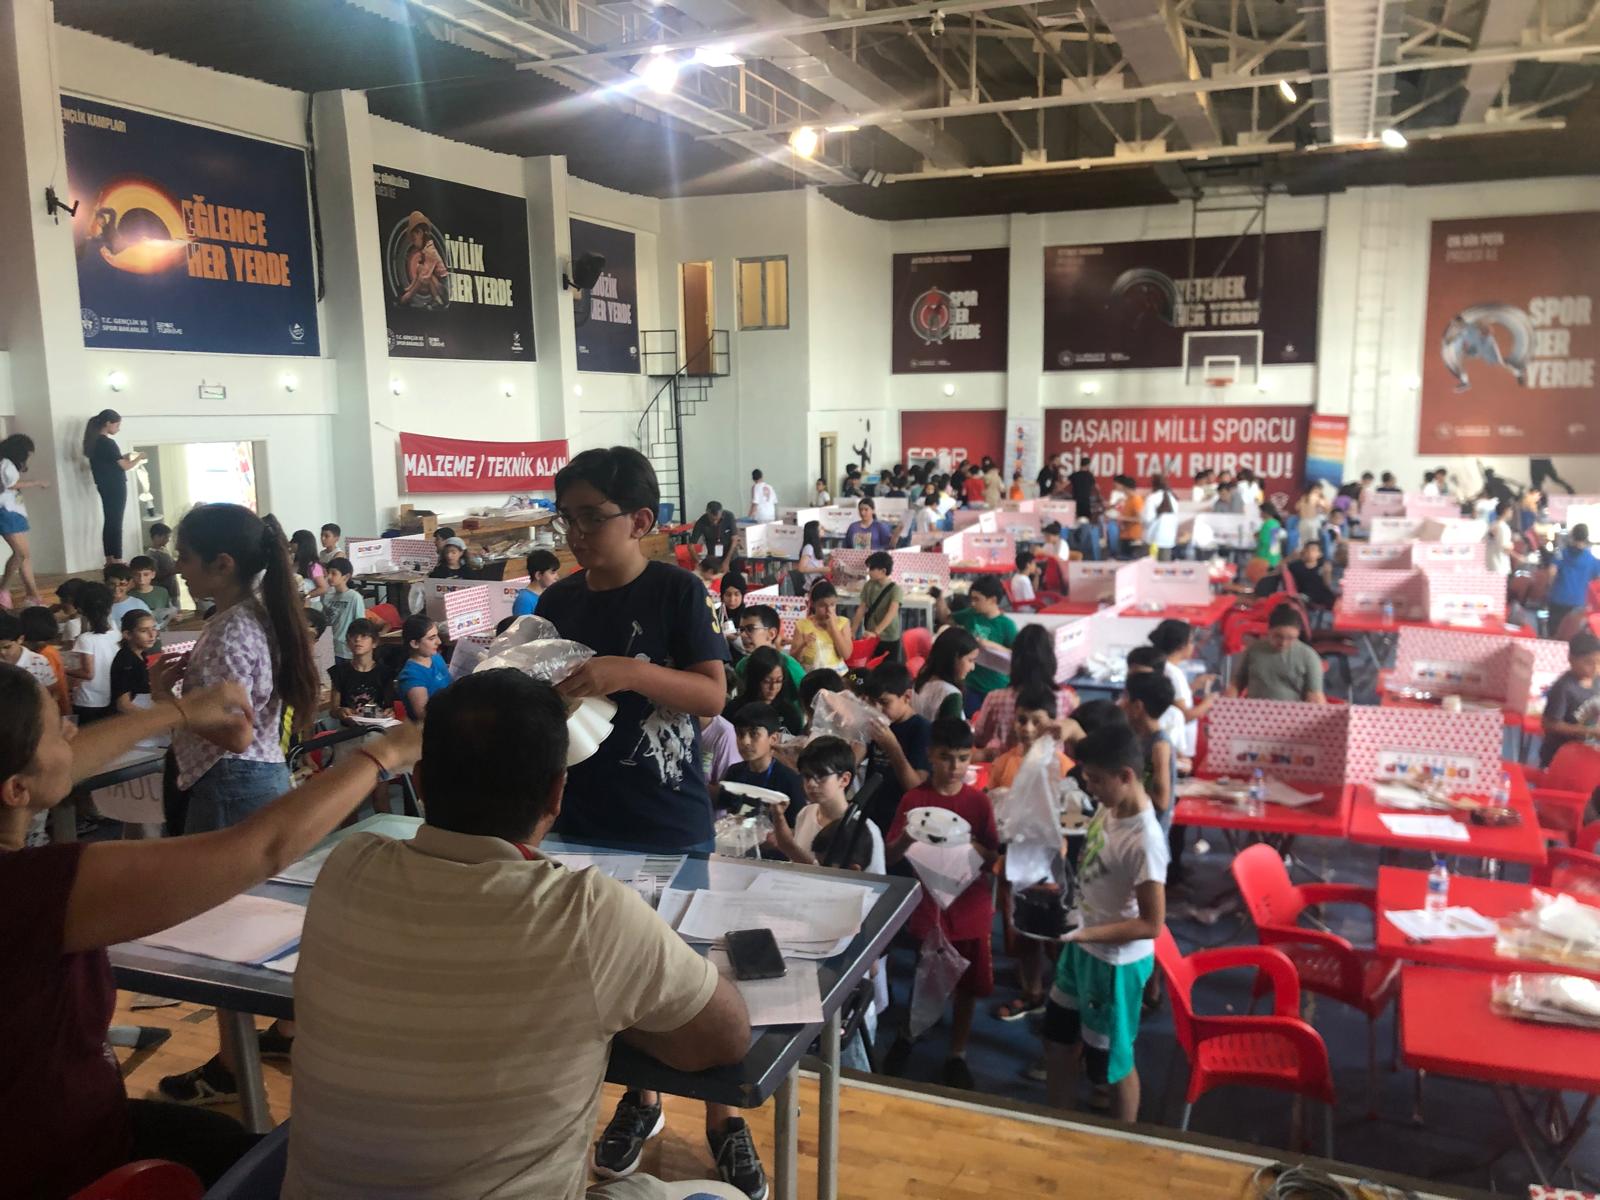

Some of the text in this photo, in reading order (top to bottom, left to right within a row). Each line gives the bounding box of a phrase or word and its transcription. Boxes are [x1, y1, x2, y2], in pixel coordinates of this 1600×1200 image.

[62, 108, 86, 124] ENÇLİK
[181, 194, 268, 247] EĞLENCE
[186, 242, 292, 287] HER YERDE
[445, 233, 485, 272] İYİLİK
[447, 272, 514, 307] HER YERDE
[949, 290, 978, 307] SPOR
[590, 297, 632, 324] HER YERDE
[1528, 296, 1592, 327] SPOR
[949, 324, 981, 340] YERDE
[1526, 359, 1596, 389] YERDE
[1059, 415, 1297, 448] BAŞARILI MİLLİ SPORCU
[403, 453, 476, 477] MALZEME
[476, 454, 486, 480] /
[487, 451, 535, 477] TEKNİK
[1134, 452, 1182, 478] TAM
